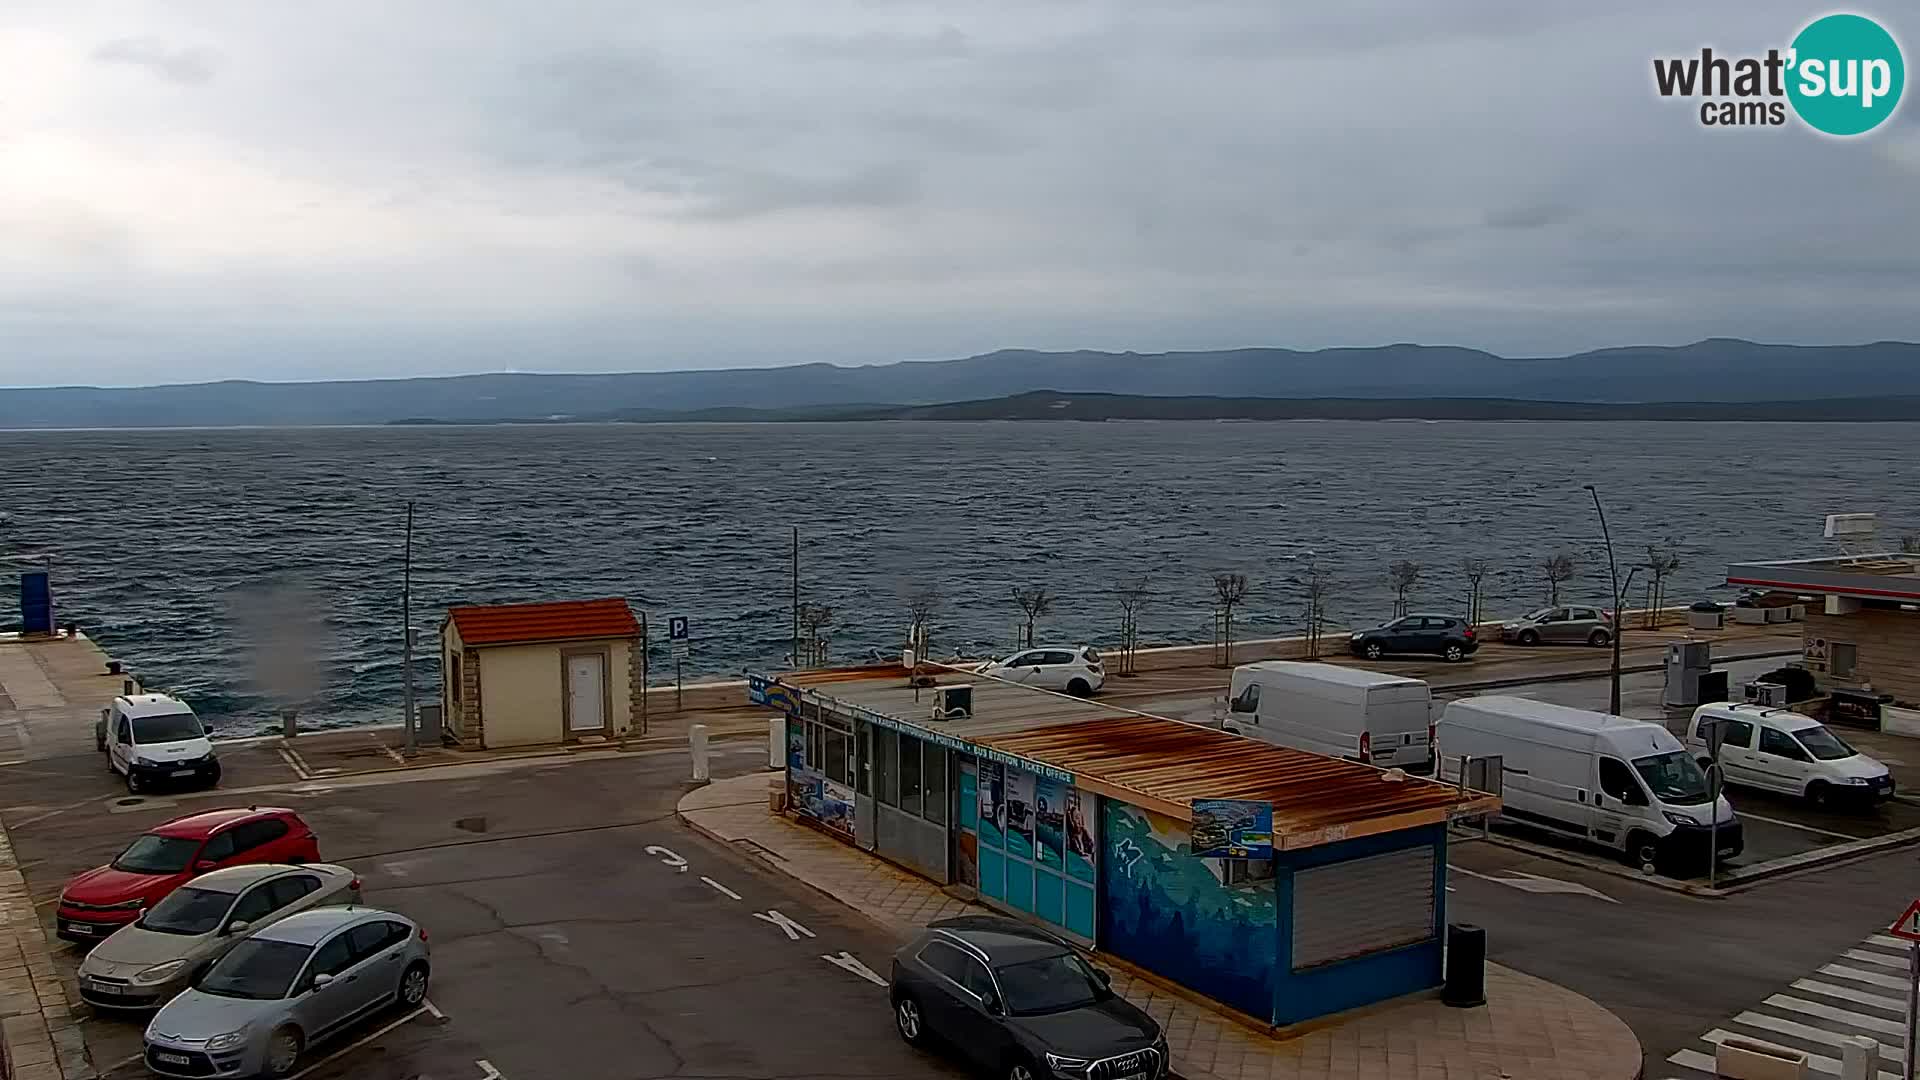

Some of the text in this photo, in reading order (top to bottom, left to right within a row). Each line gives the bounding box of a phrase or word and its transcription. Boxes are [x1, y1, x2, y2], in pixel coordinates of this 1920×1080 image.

[673, 619, 684, 637] P
[974, 745, 987, 757] BUS
[1020, 759, 1044, 775] TICKET
[1046, 767, 1071, 783] OFFICE
